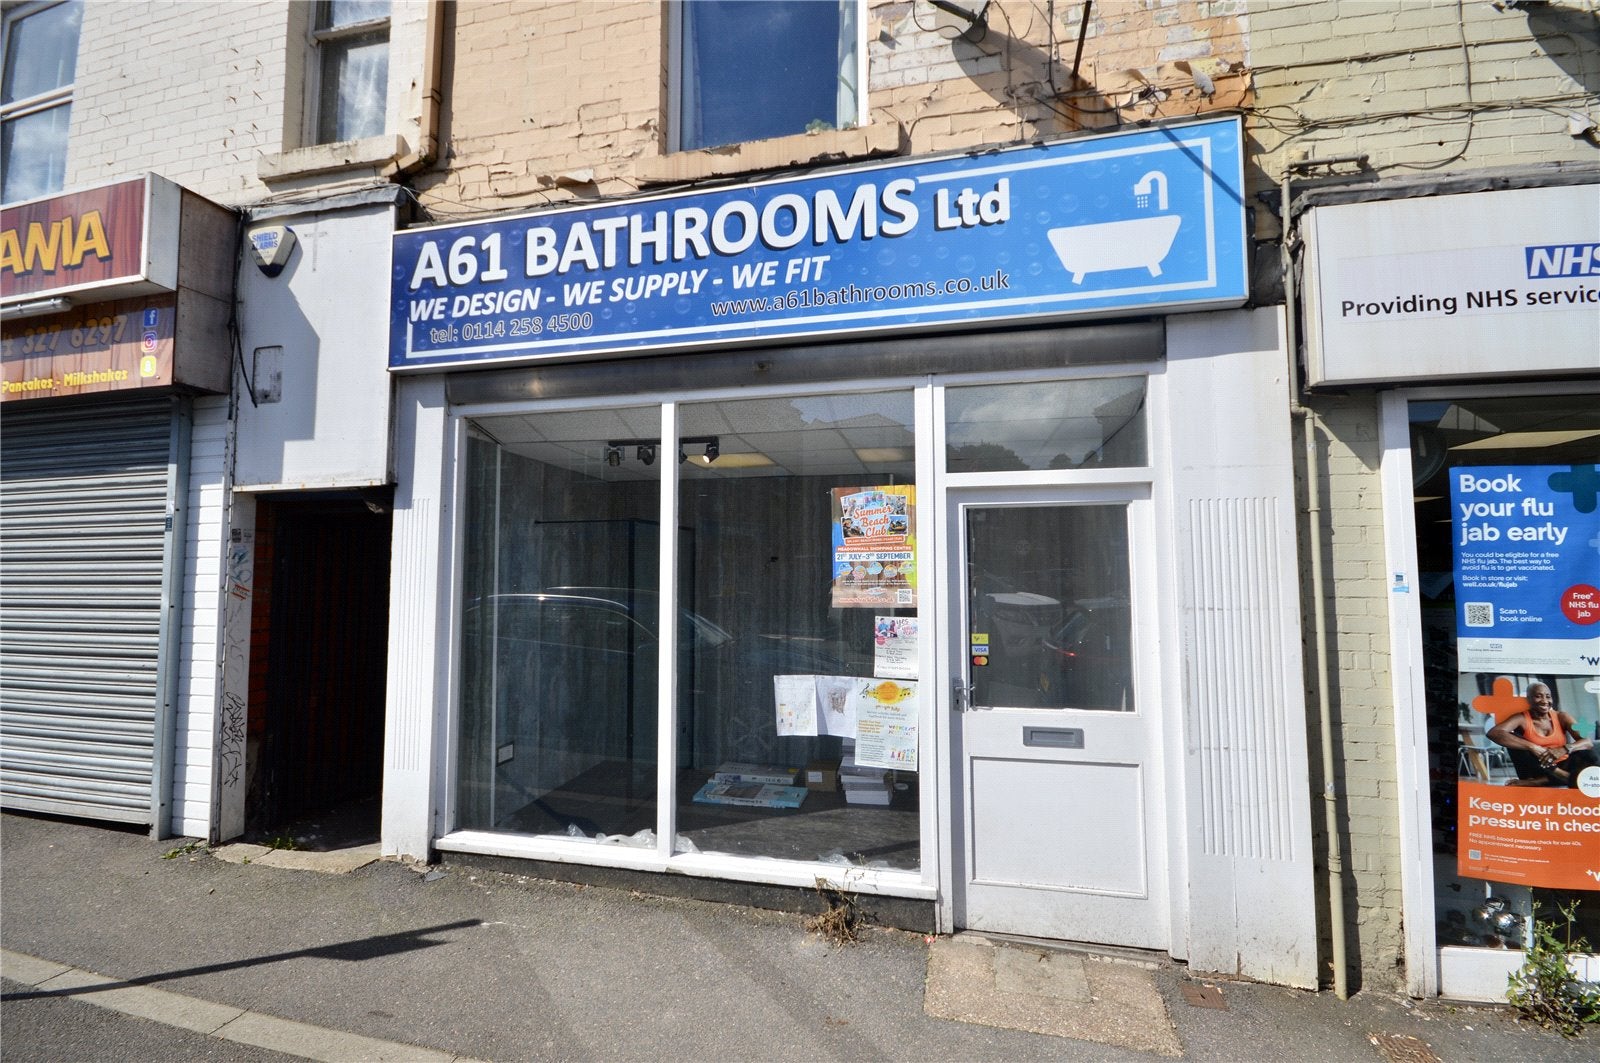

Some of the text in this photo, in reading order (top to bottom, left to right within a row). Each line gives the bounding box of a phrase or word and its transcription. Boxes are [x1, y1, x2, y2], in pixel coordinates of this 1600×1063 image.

[0, 209, 111, 276] ANIA
[252, 231, 278, 242] SHIELD
[410, 177, 1011, 290] A61 BATHROOMS Ltd
[1528, 246, 1600, 278] NHS
[410, 297, 446, 322] WE
[451, 287, 541, 318] DESIGN
[563, 281, 602, 307] WE
[608, 268, 709, 302] SUPPLY
[731, 260, 779, 290] WE
[785, 255, 831, 284] FIT
[711, 269, 1010, 317] www.a61bathrooms.co.uk
[1342, 294, 1457, 317] Providing
[1466, 288, 1518, 309] NHS
[23, 324, 62, 354] 327
[70, 314, 128, 348] 6297
[430, 312, 593, 344] tel: 0114 258 4500
[1, 377, 53, 394] Pancakes
[63, 369, 129, 387] Milkshakes
[1459, 474, 1522, 493] Book
[854, 505, 892, 519] Summer
[860, 515, 889, 527] Beach
[1459, 498, 1554, 521] your flu
[865, 526, 886, 538] Club
[1459, 522, 1568, 546] jab early
[1569, 601, 1599, 609] NHS flu
[1577, 610, 1591, 618] jab
[1469, 796, 1600, 816] Keep your blood
[1469, 814, 1600, 833] pressure in chec
